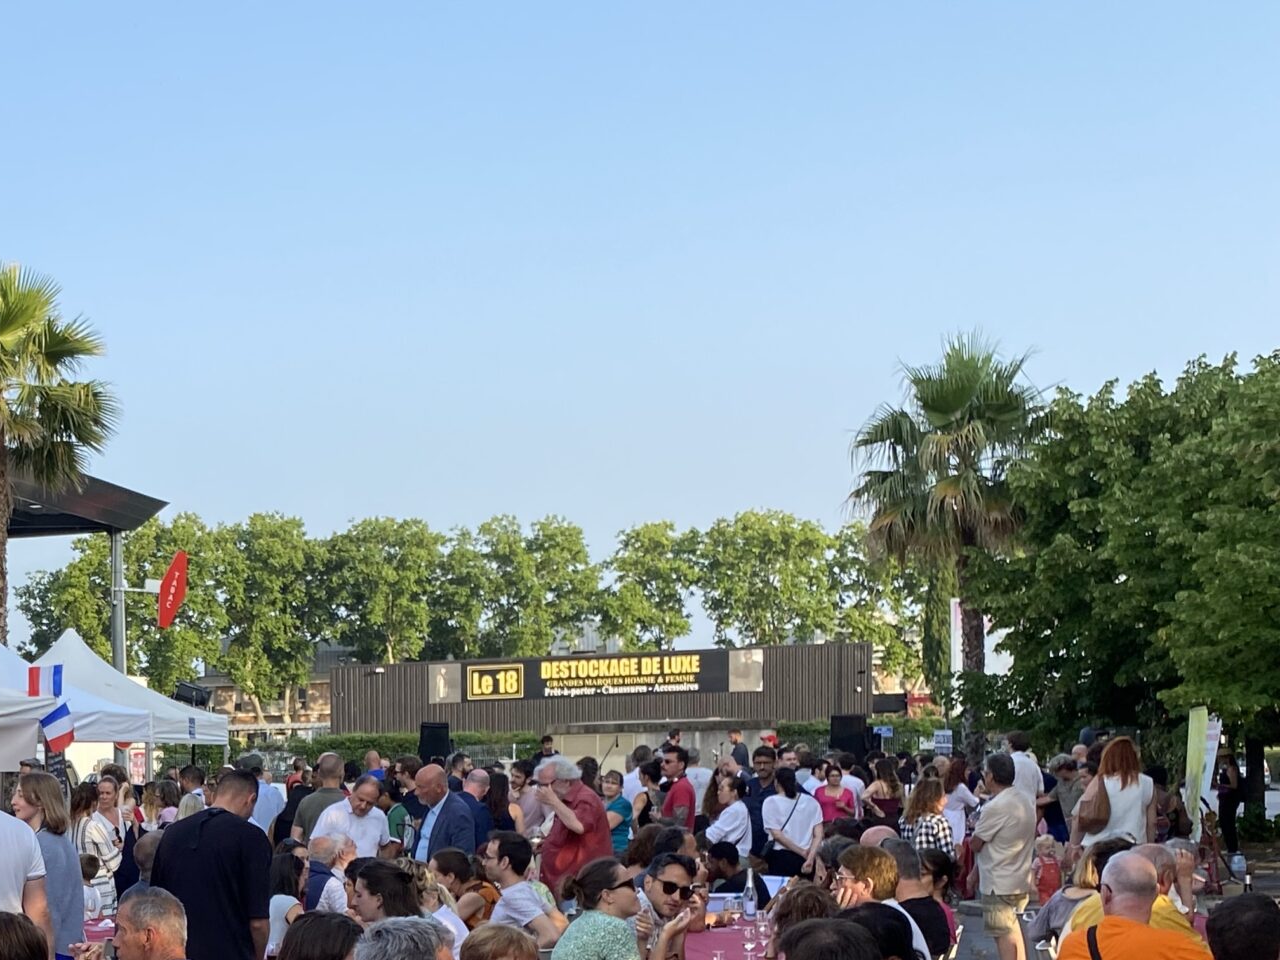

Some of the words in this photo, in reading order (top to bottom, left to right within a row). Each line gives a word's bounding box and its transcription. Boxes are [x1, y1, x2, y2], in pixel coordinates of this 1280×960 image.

[166, 571, 181, 609] TABAC
[541, 657, 639, 679] DESTOCKAGE
[641, 656, 660, 675] DE
[663, 654, 700, 674] LUXE
[472, 672, 493, 695] Le
[496, 670, 518, 694] 18
[546, 679, 584, 688] GRANDES
[585, 677, 623, 687] MARQUES
[624, 675, 656, 685] HOMME
[657, 675, 664, 683] &
[665, 674, 696, 683] FEMME
[601, 685, 647, 695] Chaussures
[653, 682, 699, 693] Accessoires
